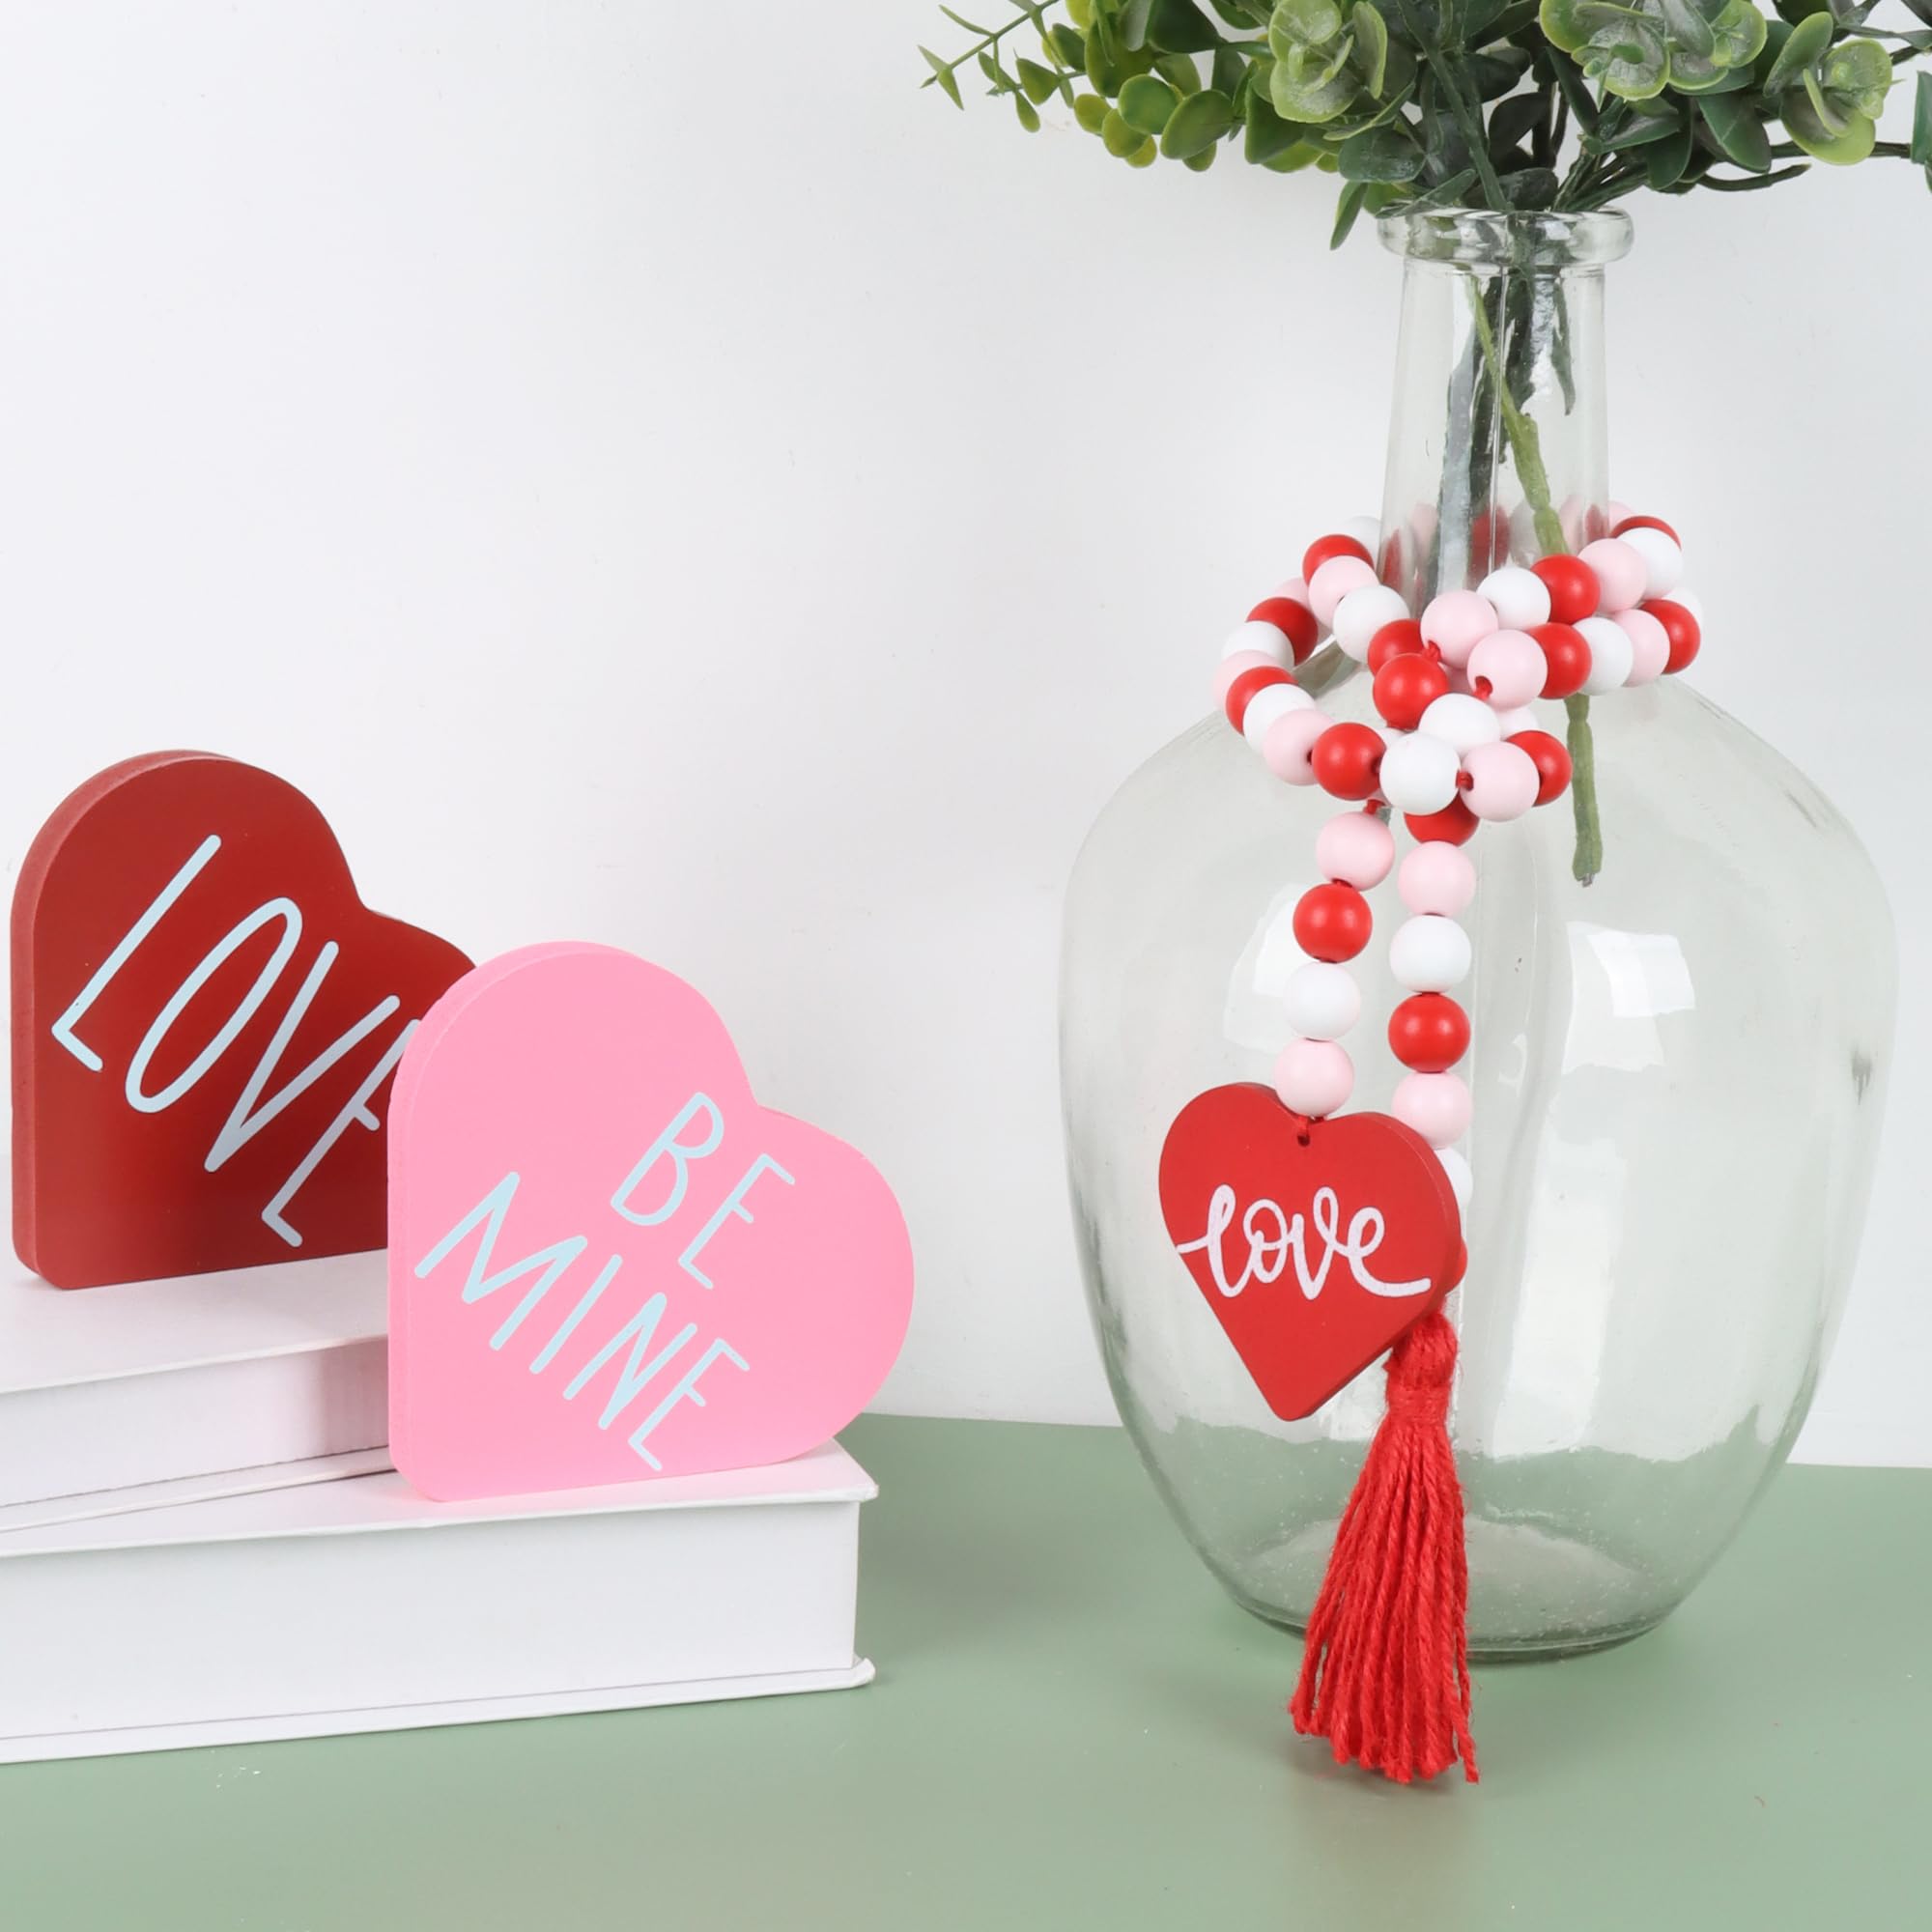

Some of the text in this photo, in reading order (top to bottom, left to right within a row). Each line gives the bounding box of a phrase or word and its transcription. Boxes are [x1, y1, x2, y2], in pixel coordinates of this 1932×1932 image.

[51, 834, 419, 1247] LOVE
[611, 1092, 796, 1290] BE
[1177, 1183, 1432, 1300] love
[413, 1171, 751, 1471] MINE
